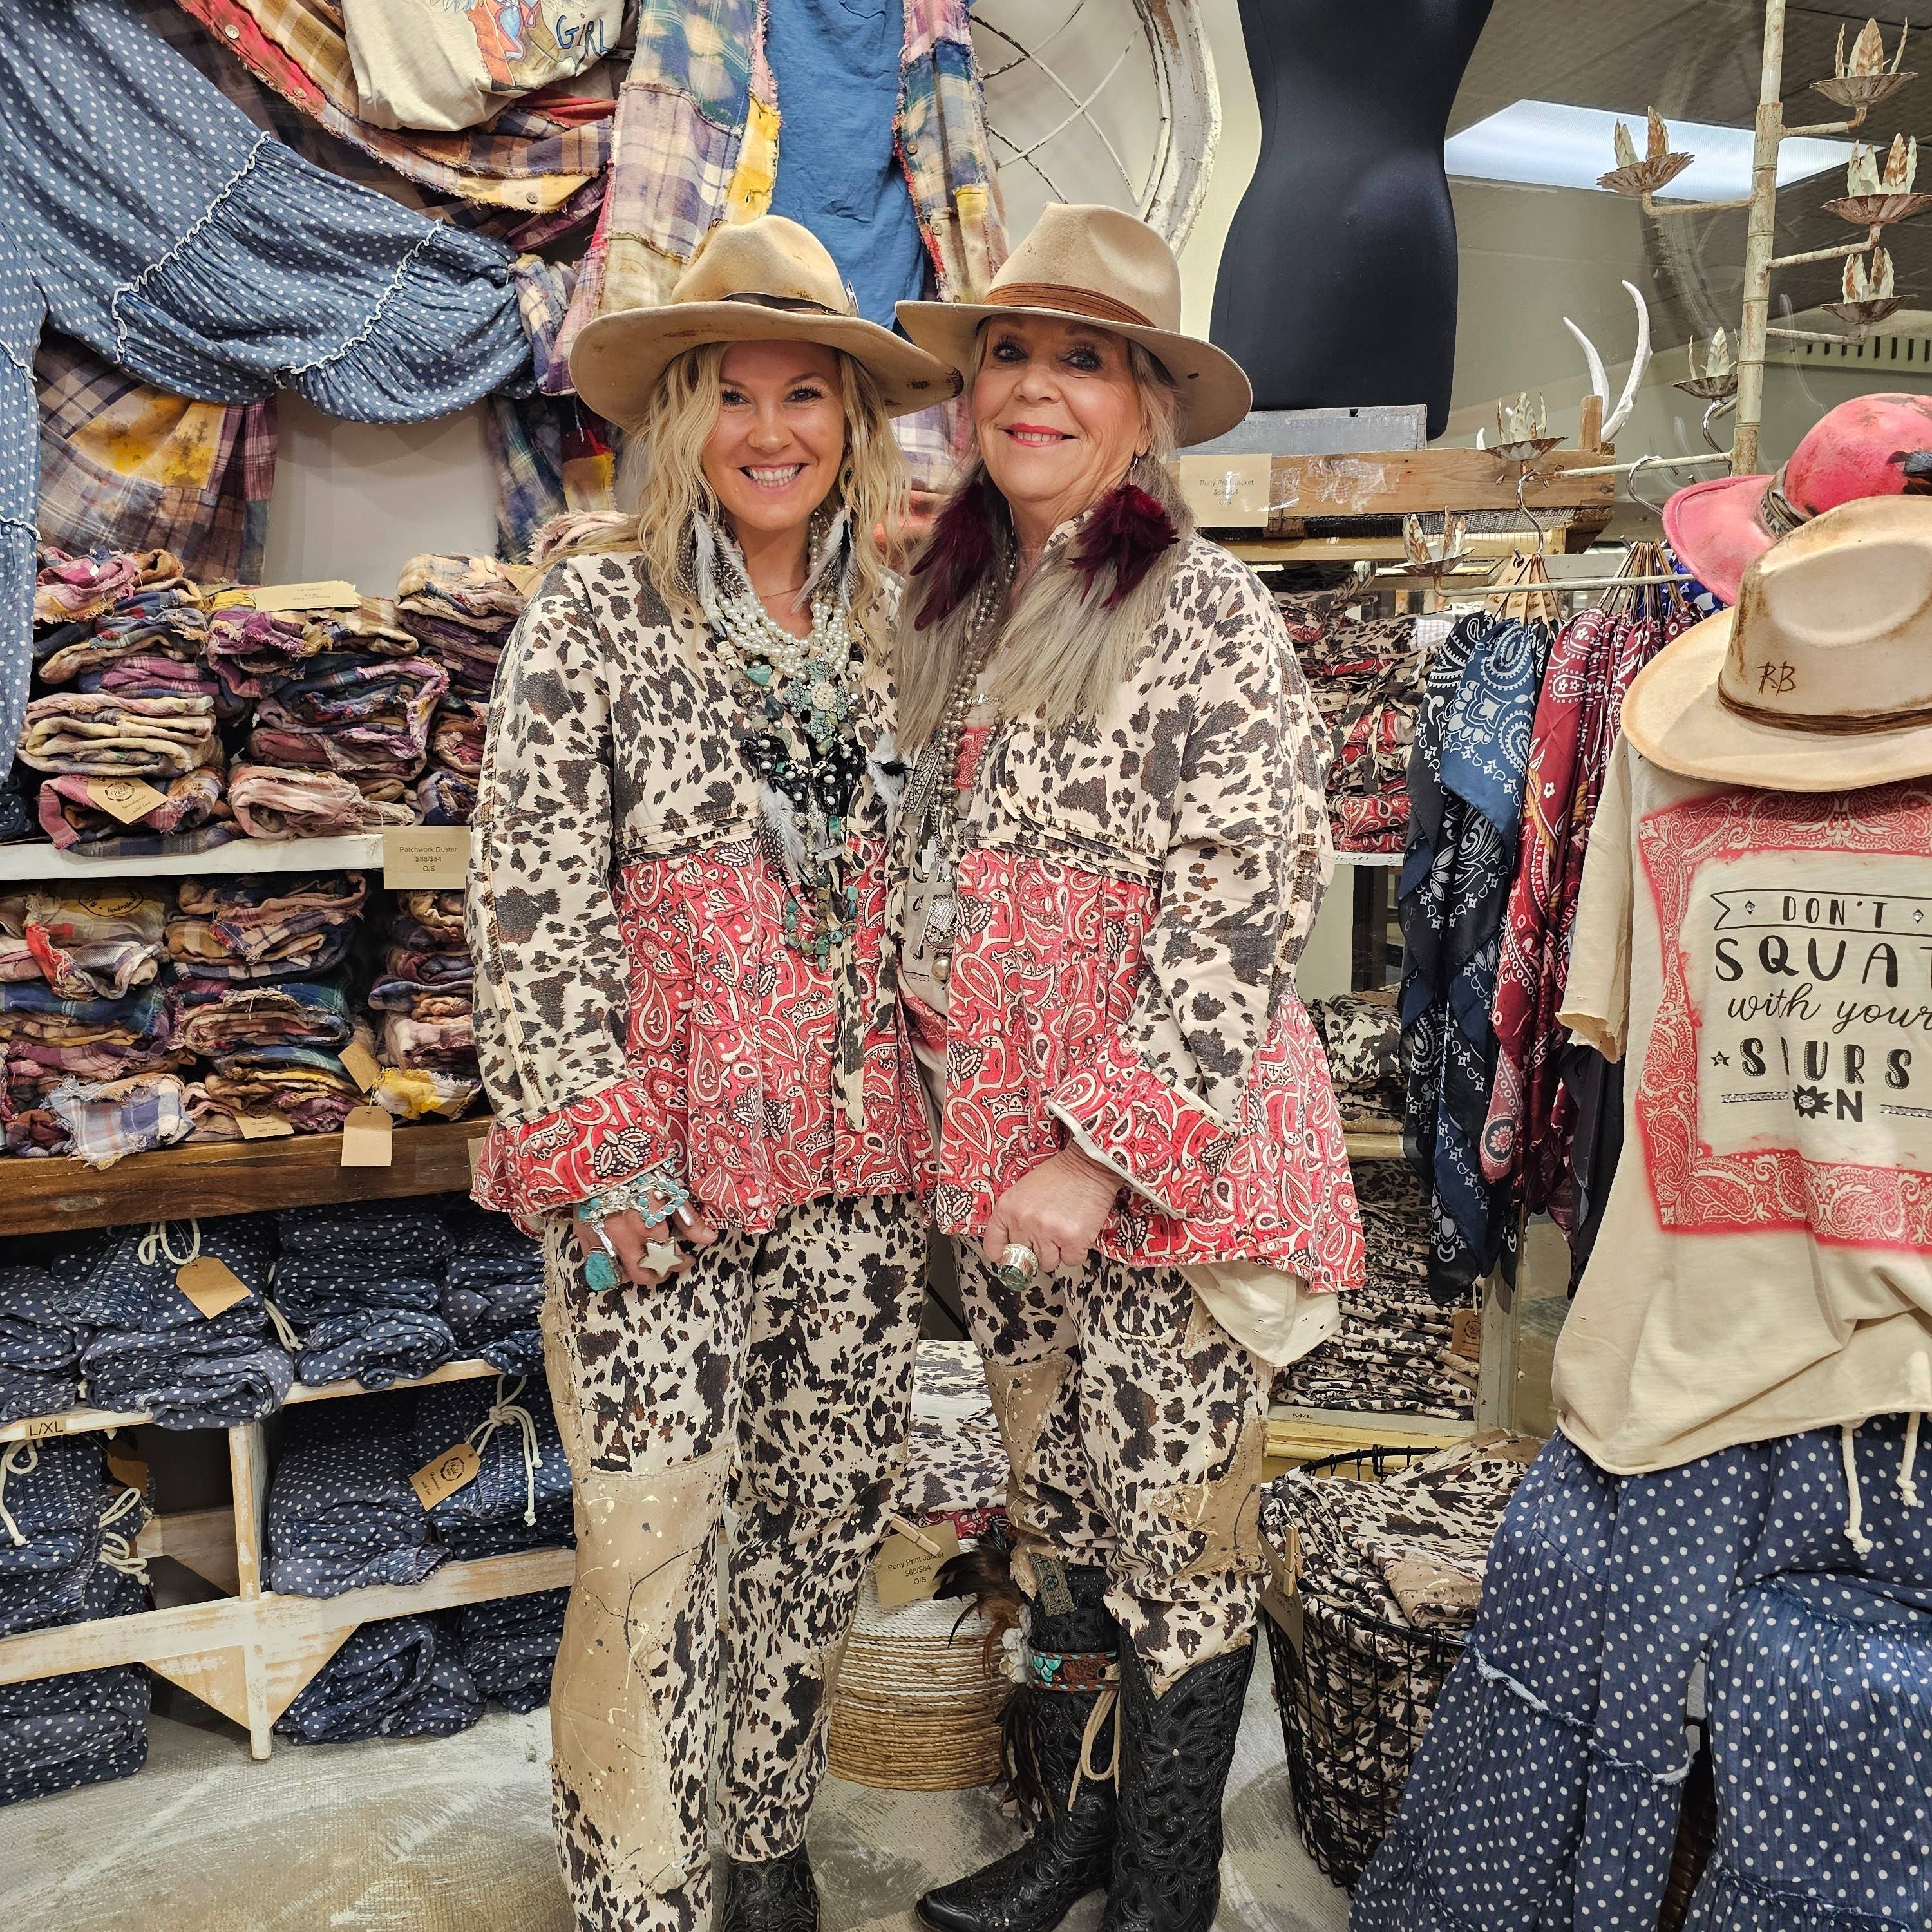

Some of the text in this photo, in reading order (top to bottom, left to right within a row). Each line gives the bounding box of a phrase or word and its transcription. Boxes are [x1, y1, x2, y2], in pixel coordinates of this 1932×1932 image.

[1783, 896, 1888, 928] DON'T
[1728, 982, 1821, 1021] with
[1739, 1037, 1912, 1090] SURS
[29, 1421, 64, 1437] L/XL
[887, 1562, 905, 1571] Pony
[905, 1556, 922, 1566] Print
[904, 1564, 932, 1577] $68/$64
[913, 1576, 927, 1585] O/S
